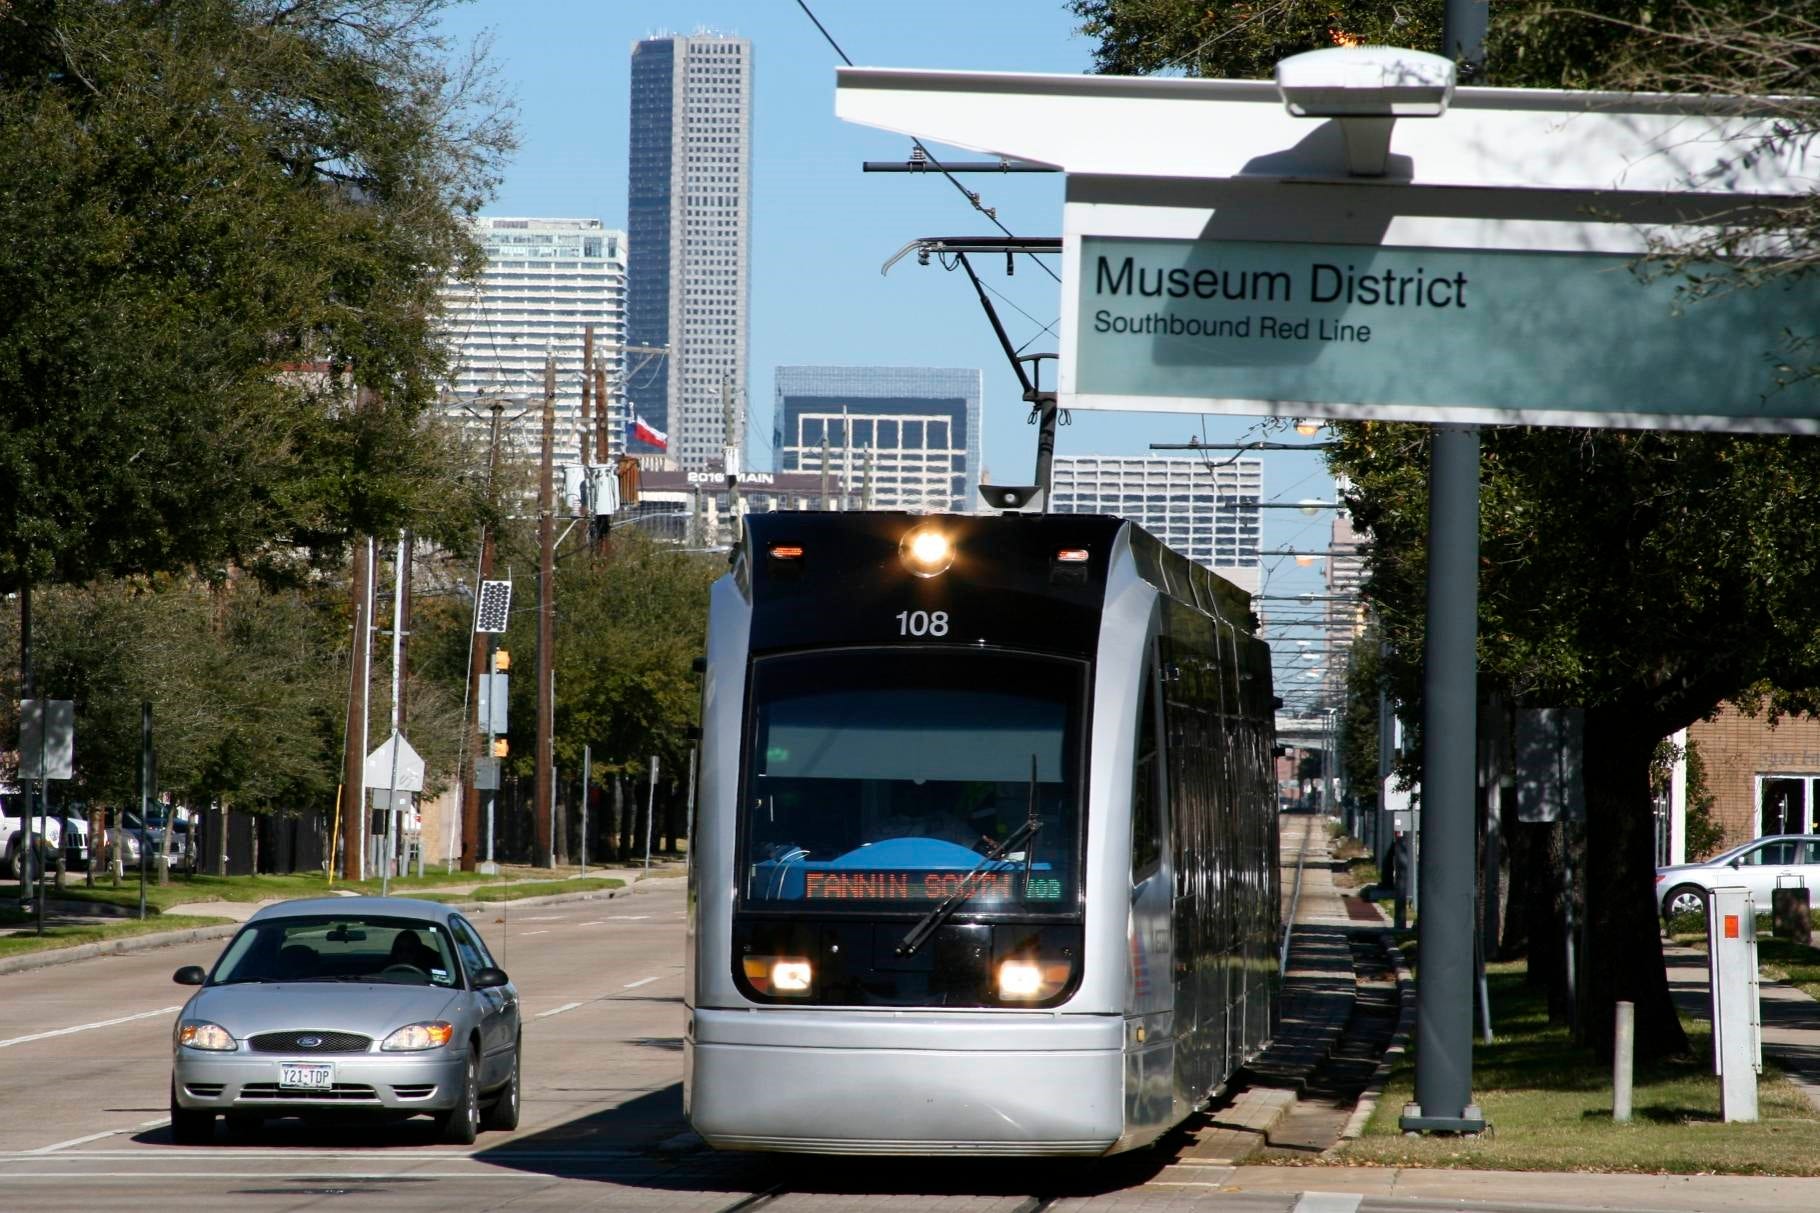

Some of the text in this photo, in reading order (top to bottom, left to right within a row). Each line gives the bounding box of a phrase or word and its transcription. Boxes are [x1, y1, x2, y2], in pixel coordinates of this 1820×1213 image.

[1095, 255, 1468, 309] Museum District
[1095, 310, 1371, 343] Southbound Red Line
[736, 472, 774, 484] MAIN
[896, 611, 948, 636] 108
[806, 873, 907, 899] FANNIN
[924, 874, 1009, 899] SOUTH
